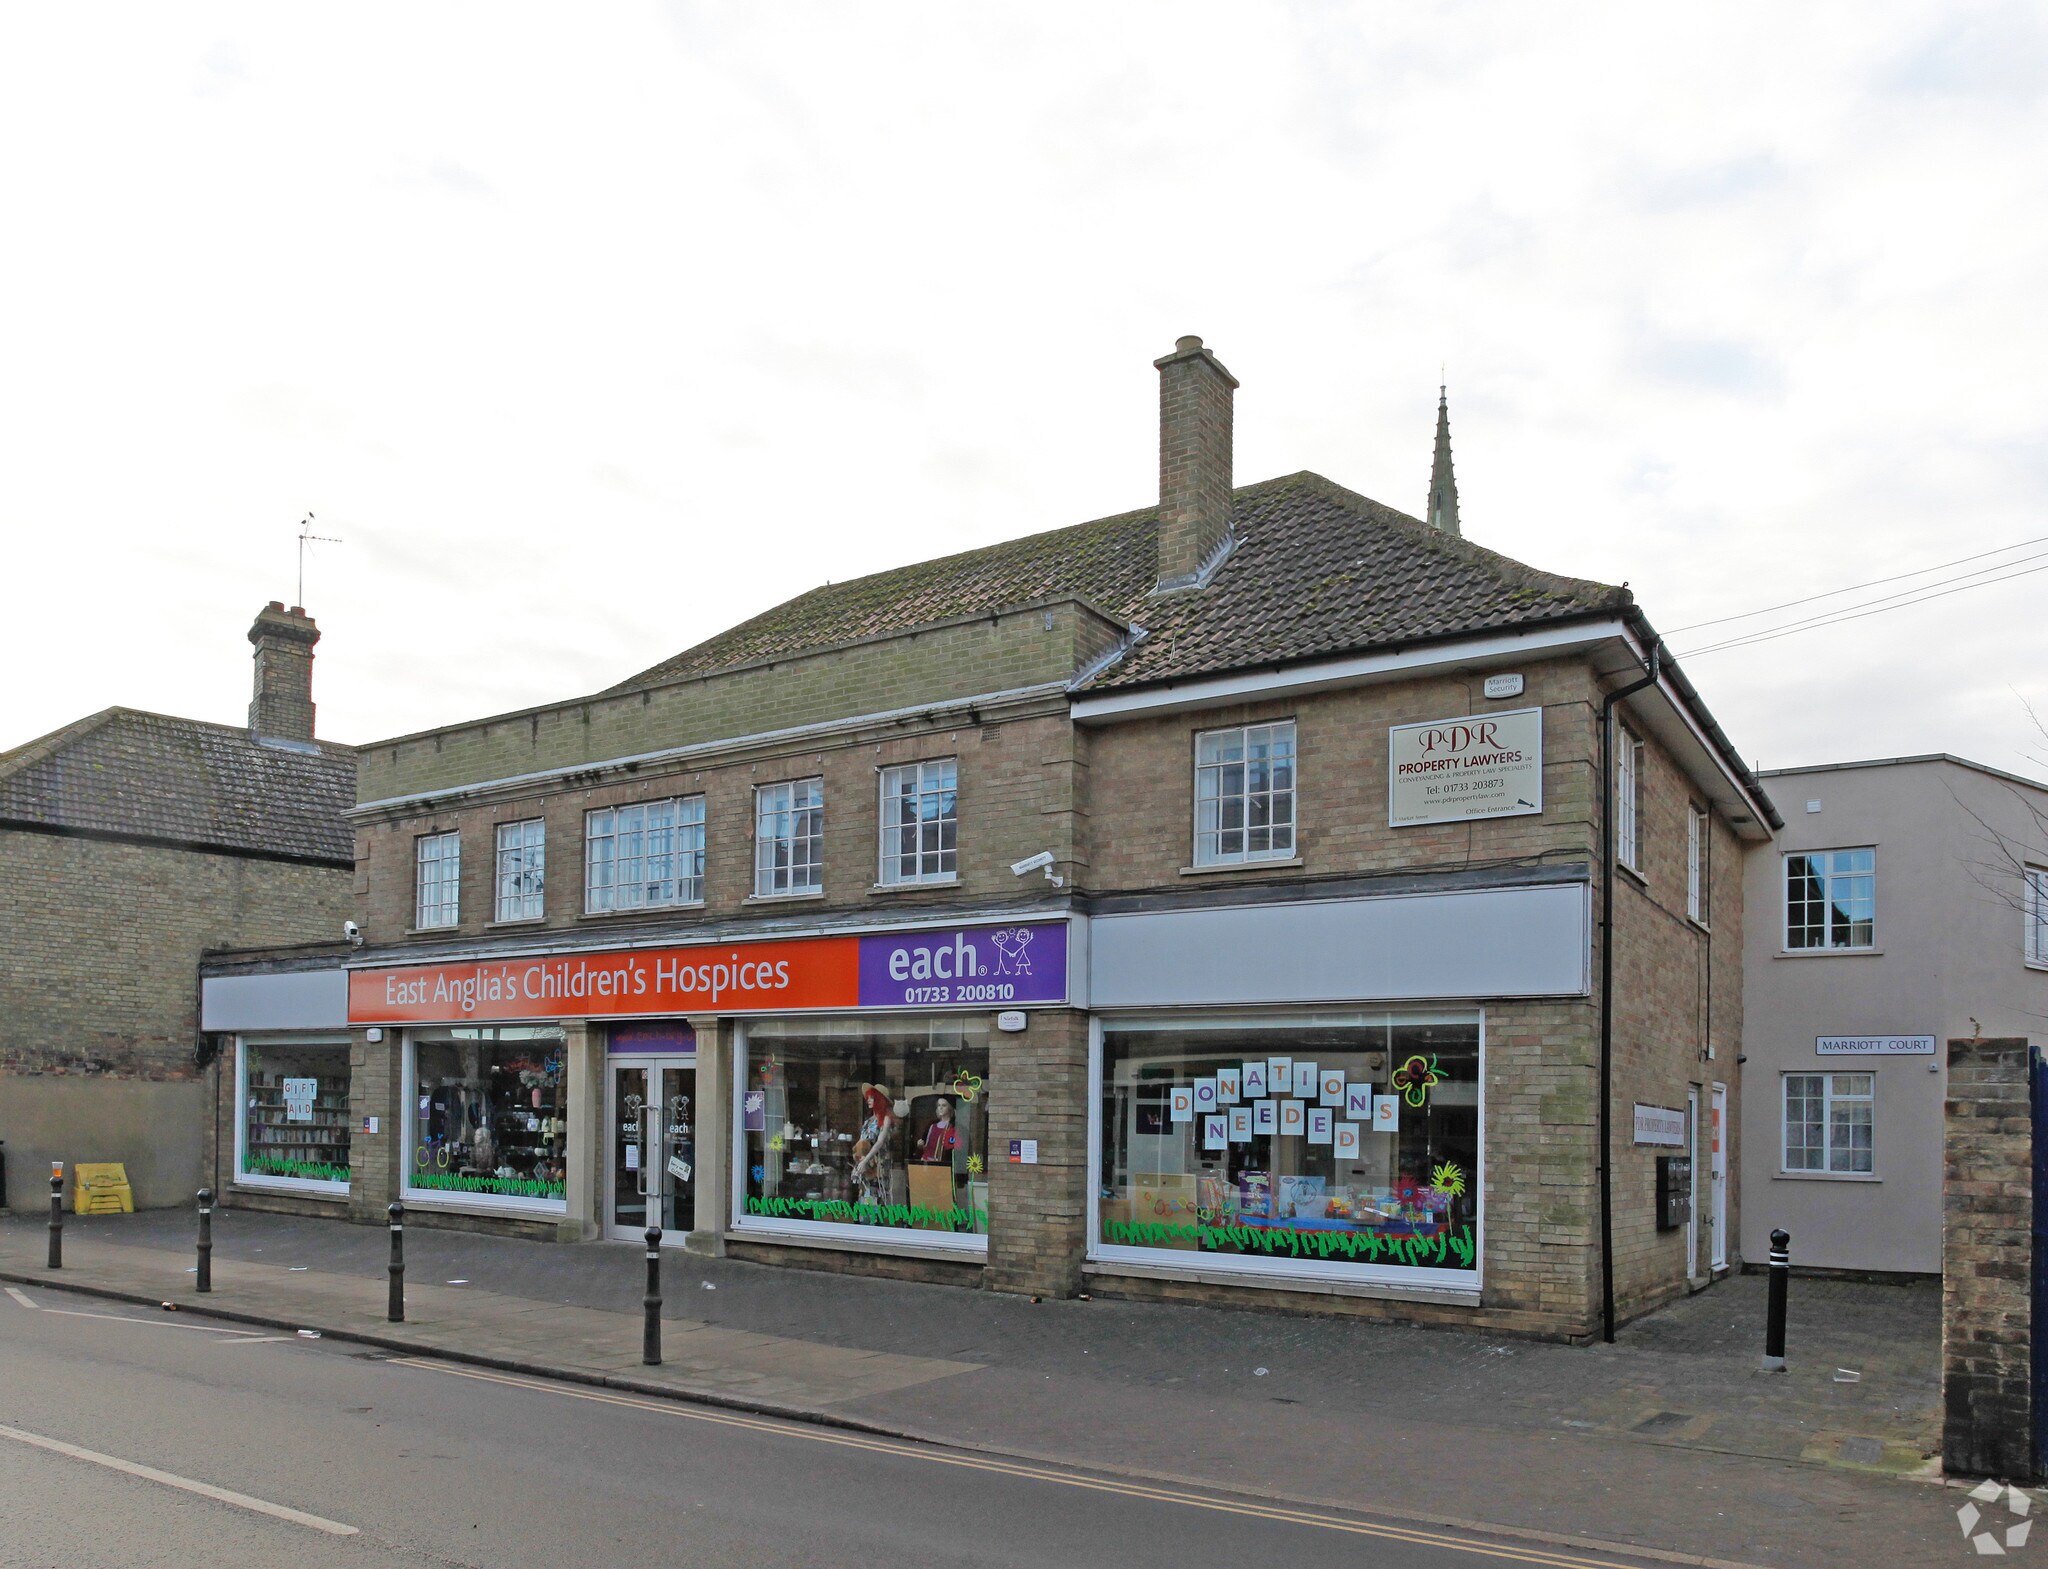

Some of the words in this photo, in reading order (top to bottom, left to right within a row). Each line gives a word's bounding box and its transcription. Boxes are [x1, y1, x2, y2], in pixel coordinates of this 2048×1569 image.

[1488, 677, 1518, 686] Marriott
[1489, 684, 1518, 693] Security
[1418, 722, 1510, 759] PDR
[1398, 757, 1460, 775] PROPERTY
[1463, 750, 1522, 768] LAWYERS
[1398, 773, 1445, 784] CONVEYANCING
[1452, 769, 1481, 778] PROPERTY
[1482, 767, 1496, 775] LAW
[1498, 763, 1533, 773] SPECIALISTS
[1425, 785, 1440, 795] Tel:
[1443, 782, 1469, 794] 01733
[1472, 778, 1505, 791] 203873
[1423, 791, 1506, 805] www.pdrpropertylaw.com
[1465, 807, 1486, 815] Office
[1487, 804, 1516, 813] Entrance
[386, 974, 428, 1006] East
[433, 966, 517, 1012] Anglia's
[523, 956, 646, 1000] Children's
[656, 952, 790, 1003] Hospices
[905, 986, 950, 1004] 01733
[956, 982, 1015, 1002] 200810
[1822, 1040, 1882, 1050] MARRIOTT
[1888, 1040, 1929, 1050] COURT
[284, 1083, 316, 1094] GIFT
[1174, 1065, 1393, 1120] DONATIONS
[288, 1103, 311, 1113] AID
[669, 1122, 689, 1134] each
[1209, 1107, 1355, 1148] NEEDED
